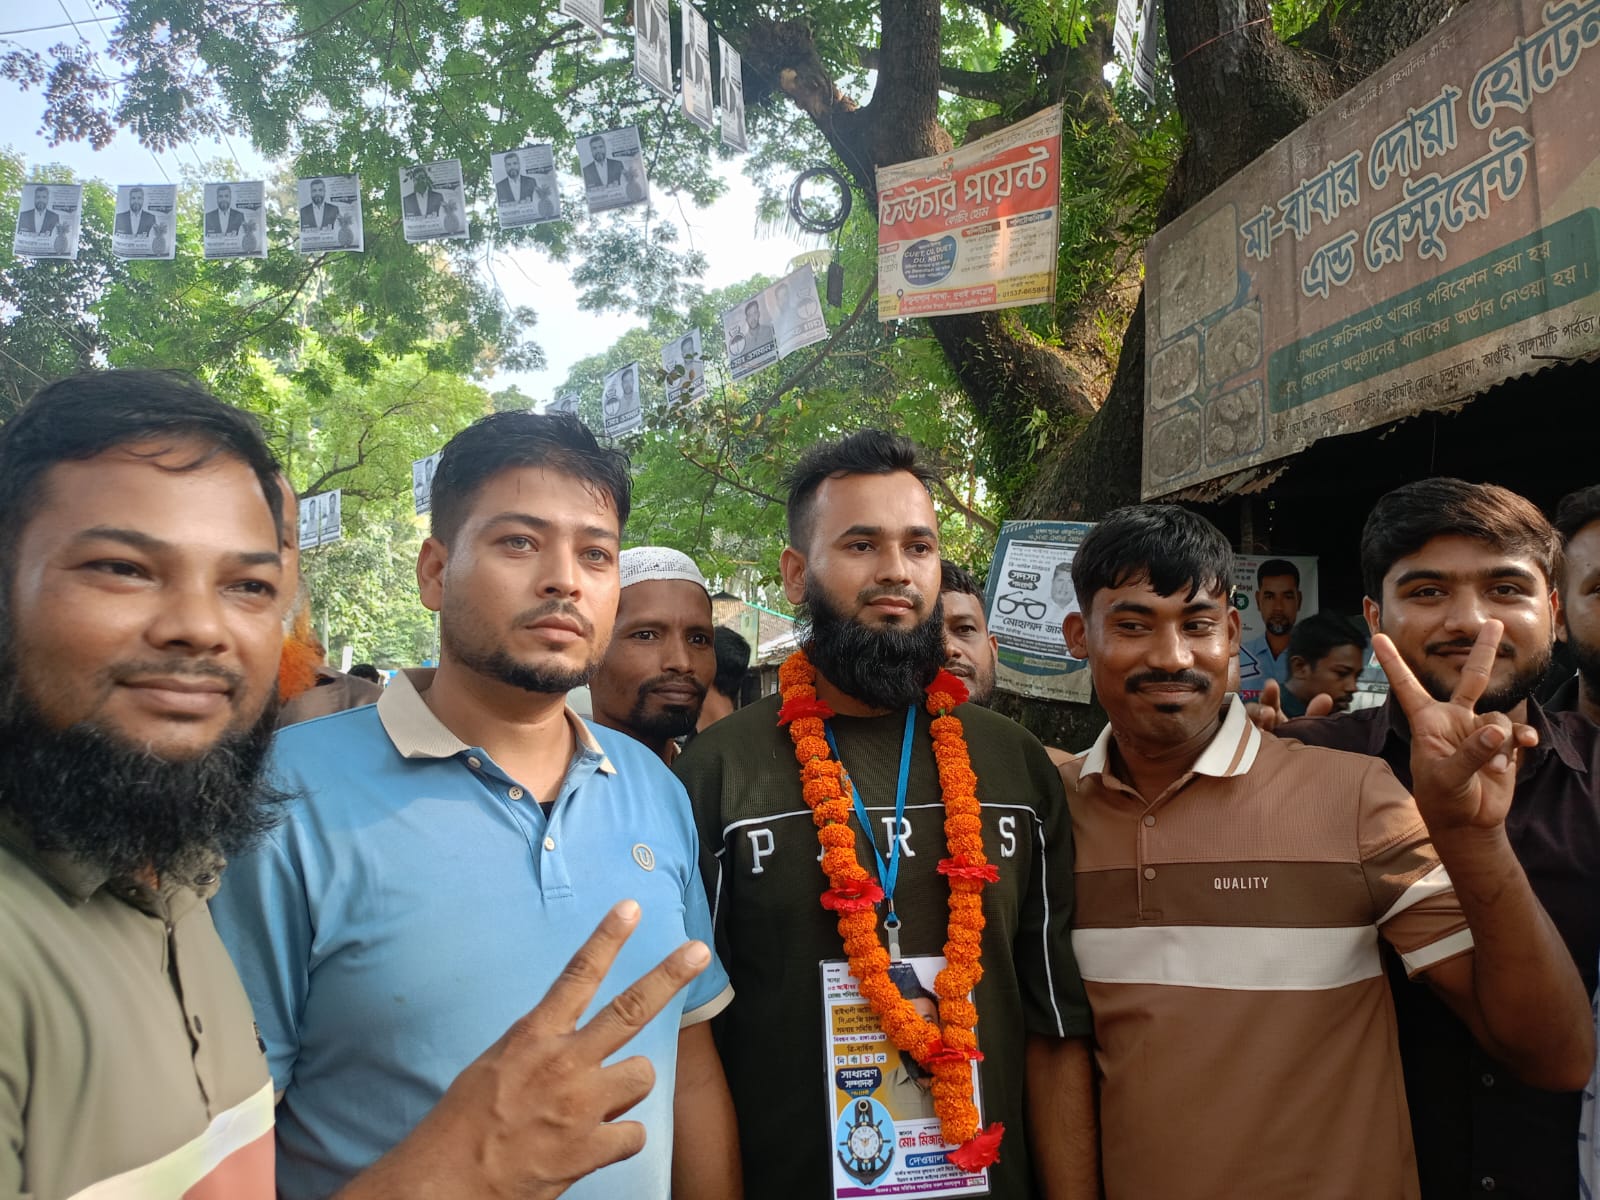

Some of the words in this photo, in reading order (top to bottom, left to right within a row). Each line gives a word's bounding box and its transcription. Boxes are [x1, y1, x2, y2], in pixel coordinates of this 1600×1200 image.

[964, 146, 1050, 205] পয়েন্ট
[1240, 150, 1362, 260] মা-বাবার
[1367, 86, 1460, 190] দোয়া
[1302, 230, 1358, 300] এন্ড
[1363, 127, 1535, 273] রেস্টুরেন্ট
[1296, 339, 1328, 362] এখানে
[1331, 315, 1383, 349] রুচিসম্মত
[1387, 298, 1422, 323] খাবার
[1427, 268, 1488, 307] পরিবেশন
[1492, 253, 1523, 278] করা
[1526, 240, 1551, 262] হয়
[1341, 340, 1395, 372] অনুষ্ঠানের
[1400, 317, 1450, 349] খাবারের
[1455, 297, 1495, 326] অর্ডার
[1500, 278, 1545, 311] নেওয়া
[1562, 314, 1594, 341] পার্বত্য
[1214, 877, 1268, 890] QUALITY
[840, 1069, 878, 1079] সাধারণ
[899, 1137, 916, 1149] মোঃ
[919, 1132, 946, 1149] মিজানু
